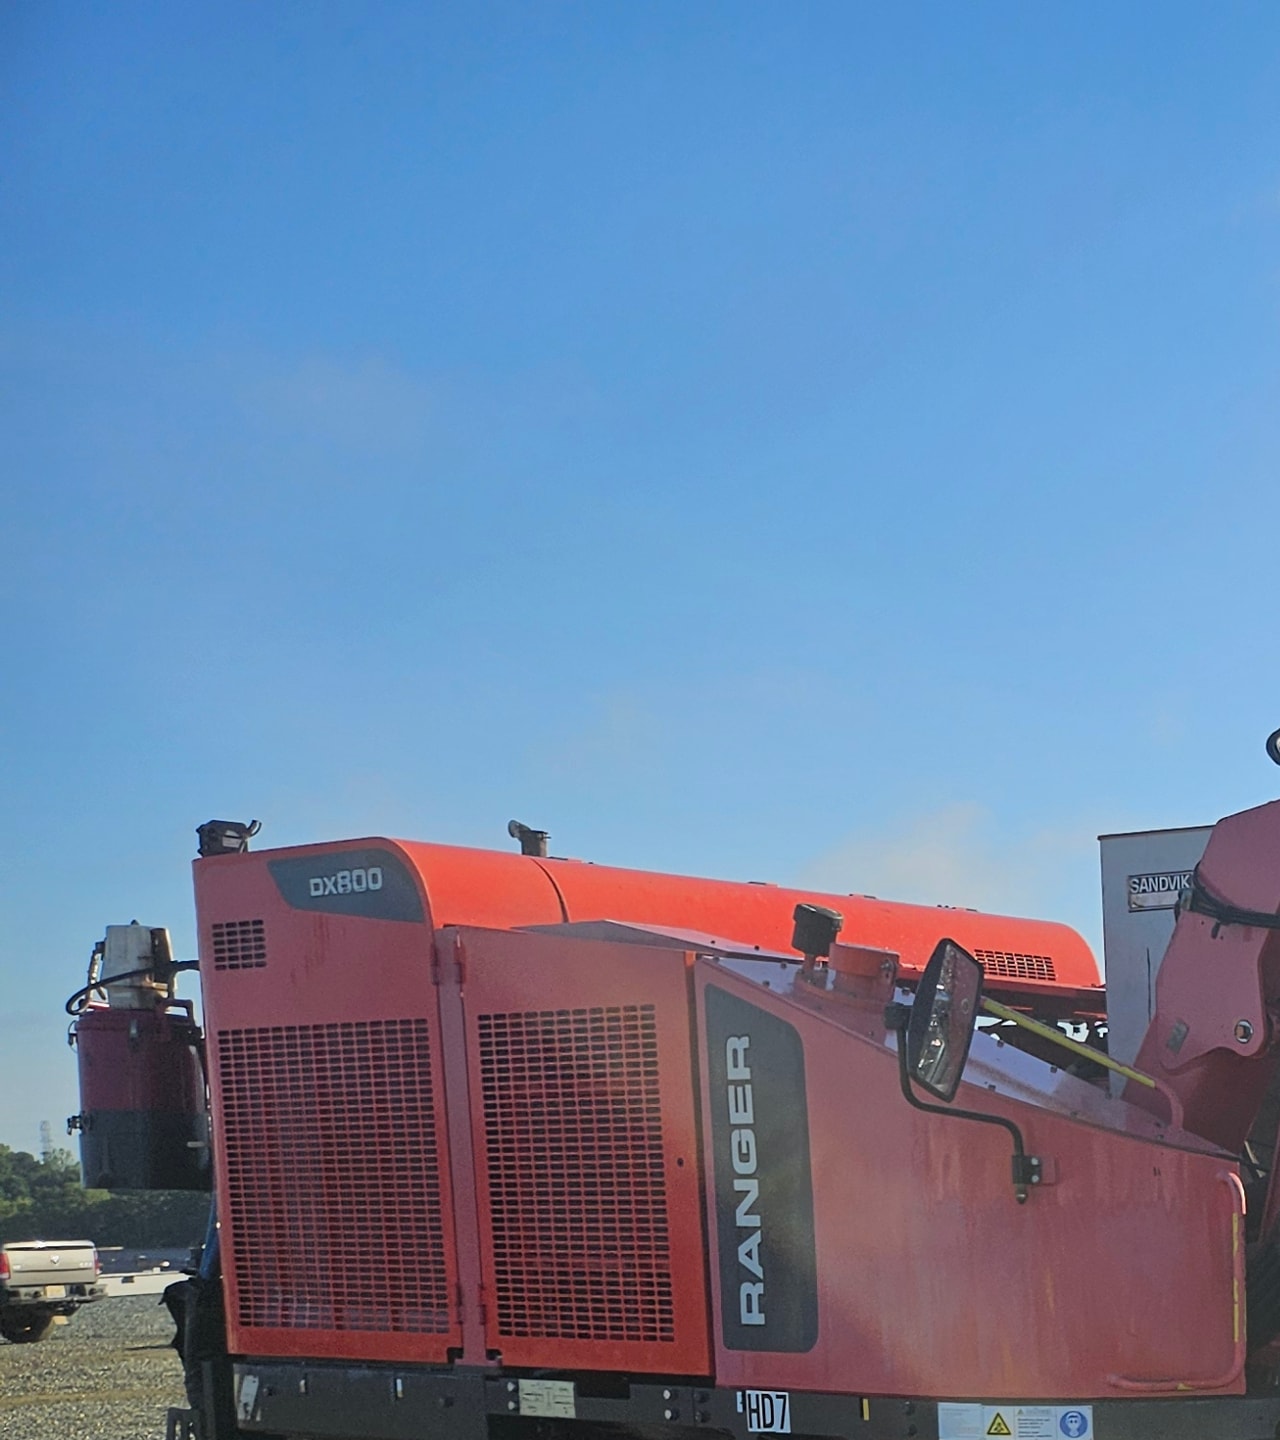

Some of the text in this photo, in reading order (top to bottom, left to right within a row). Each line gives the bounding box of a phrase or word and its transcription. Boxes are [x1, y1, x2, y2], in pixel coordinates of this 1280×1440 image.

[309, 867, 383, 896] DX800
[1130, 874, 1190, 893] SANDVIK
[726, 1035, 765, 1325] RANGER
[747, 1393, 787, 1430] HD7
